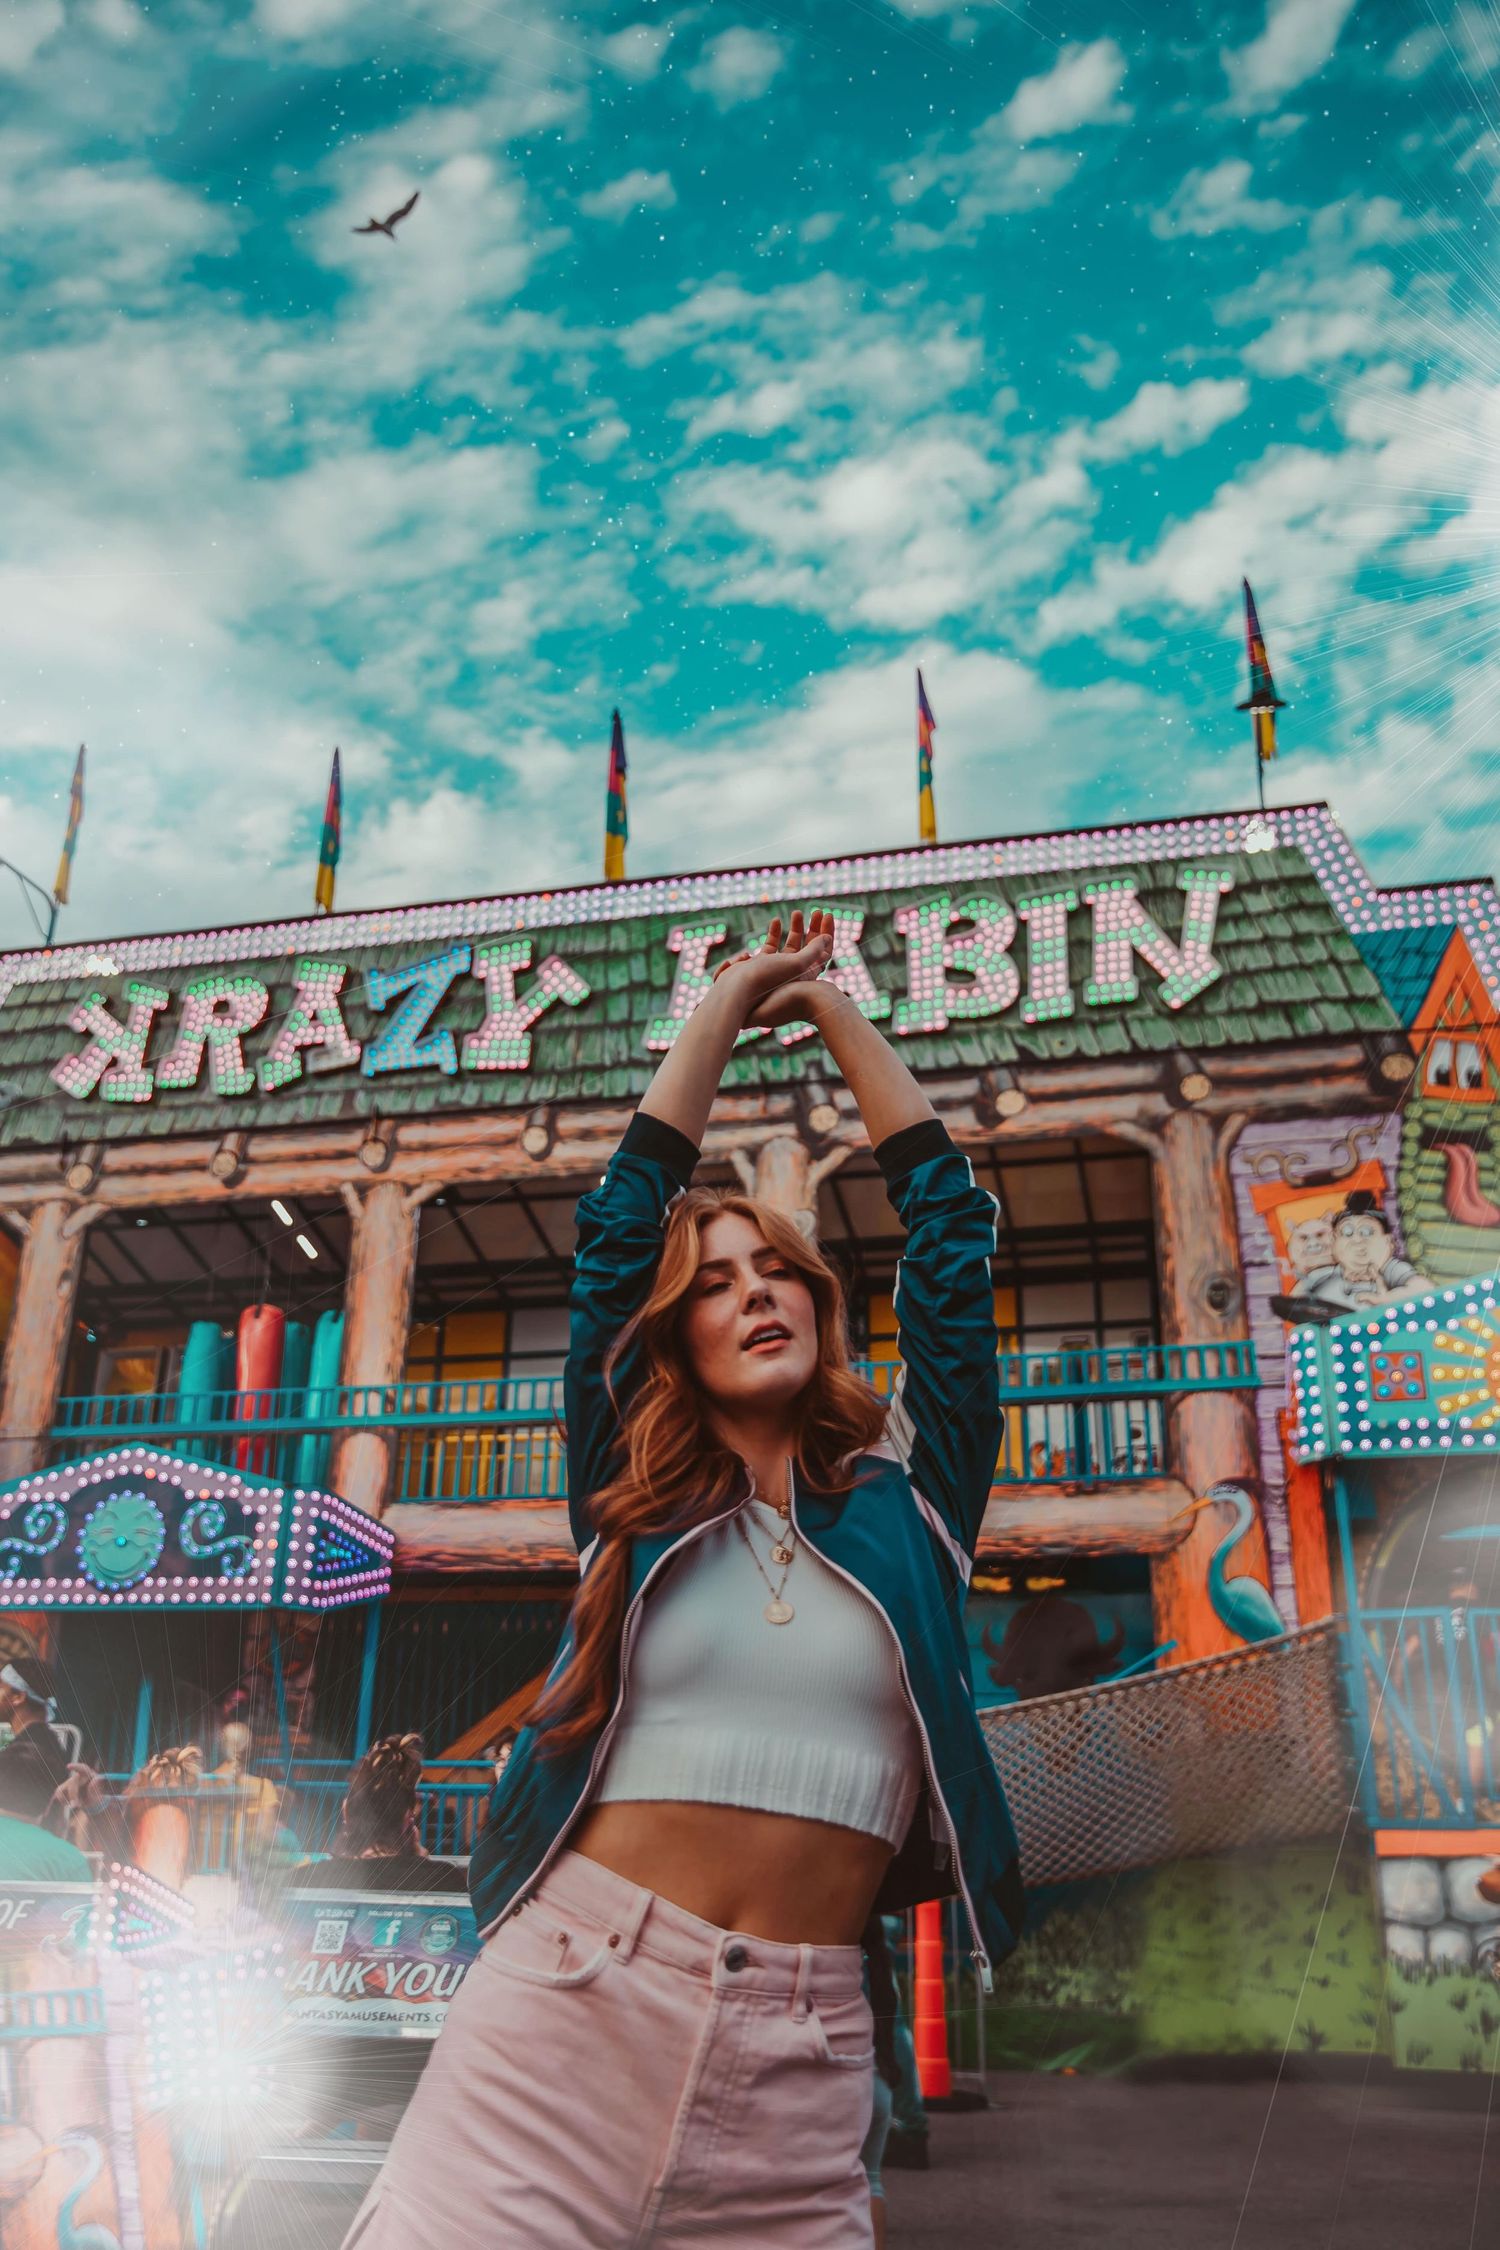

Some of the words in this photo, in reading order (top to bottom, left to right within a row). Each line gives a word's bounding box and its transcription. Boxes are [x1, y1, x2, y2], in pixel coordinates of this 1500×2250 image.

[50, 938, 591, 1103] KRAZY
[285, 1959, 378, 1995] ANK
[383, 1961, 466, 1997] YOU
